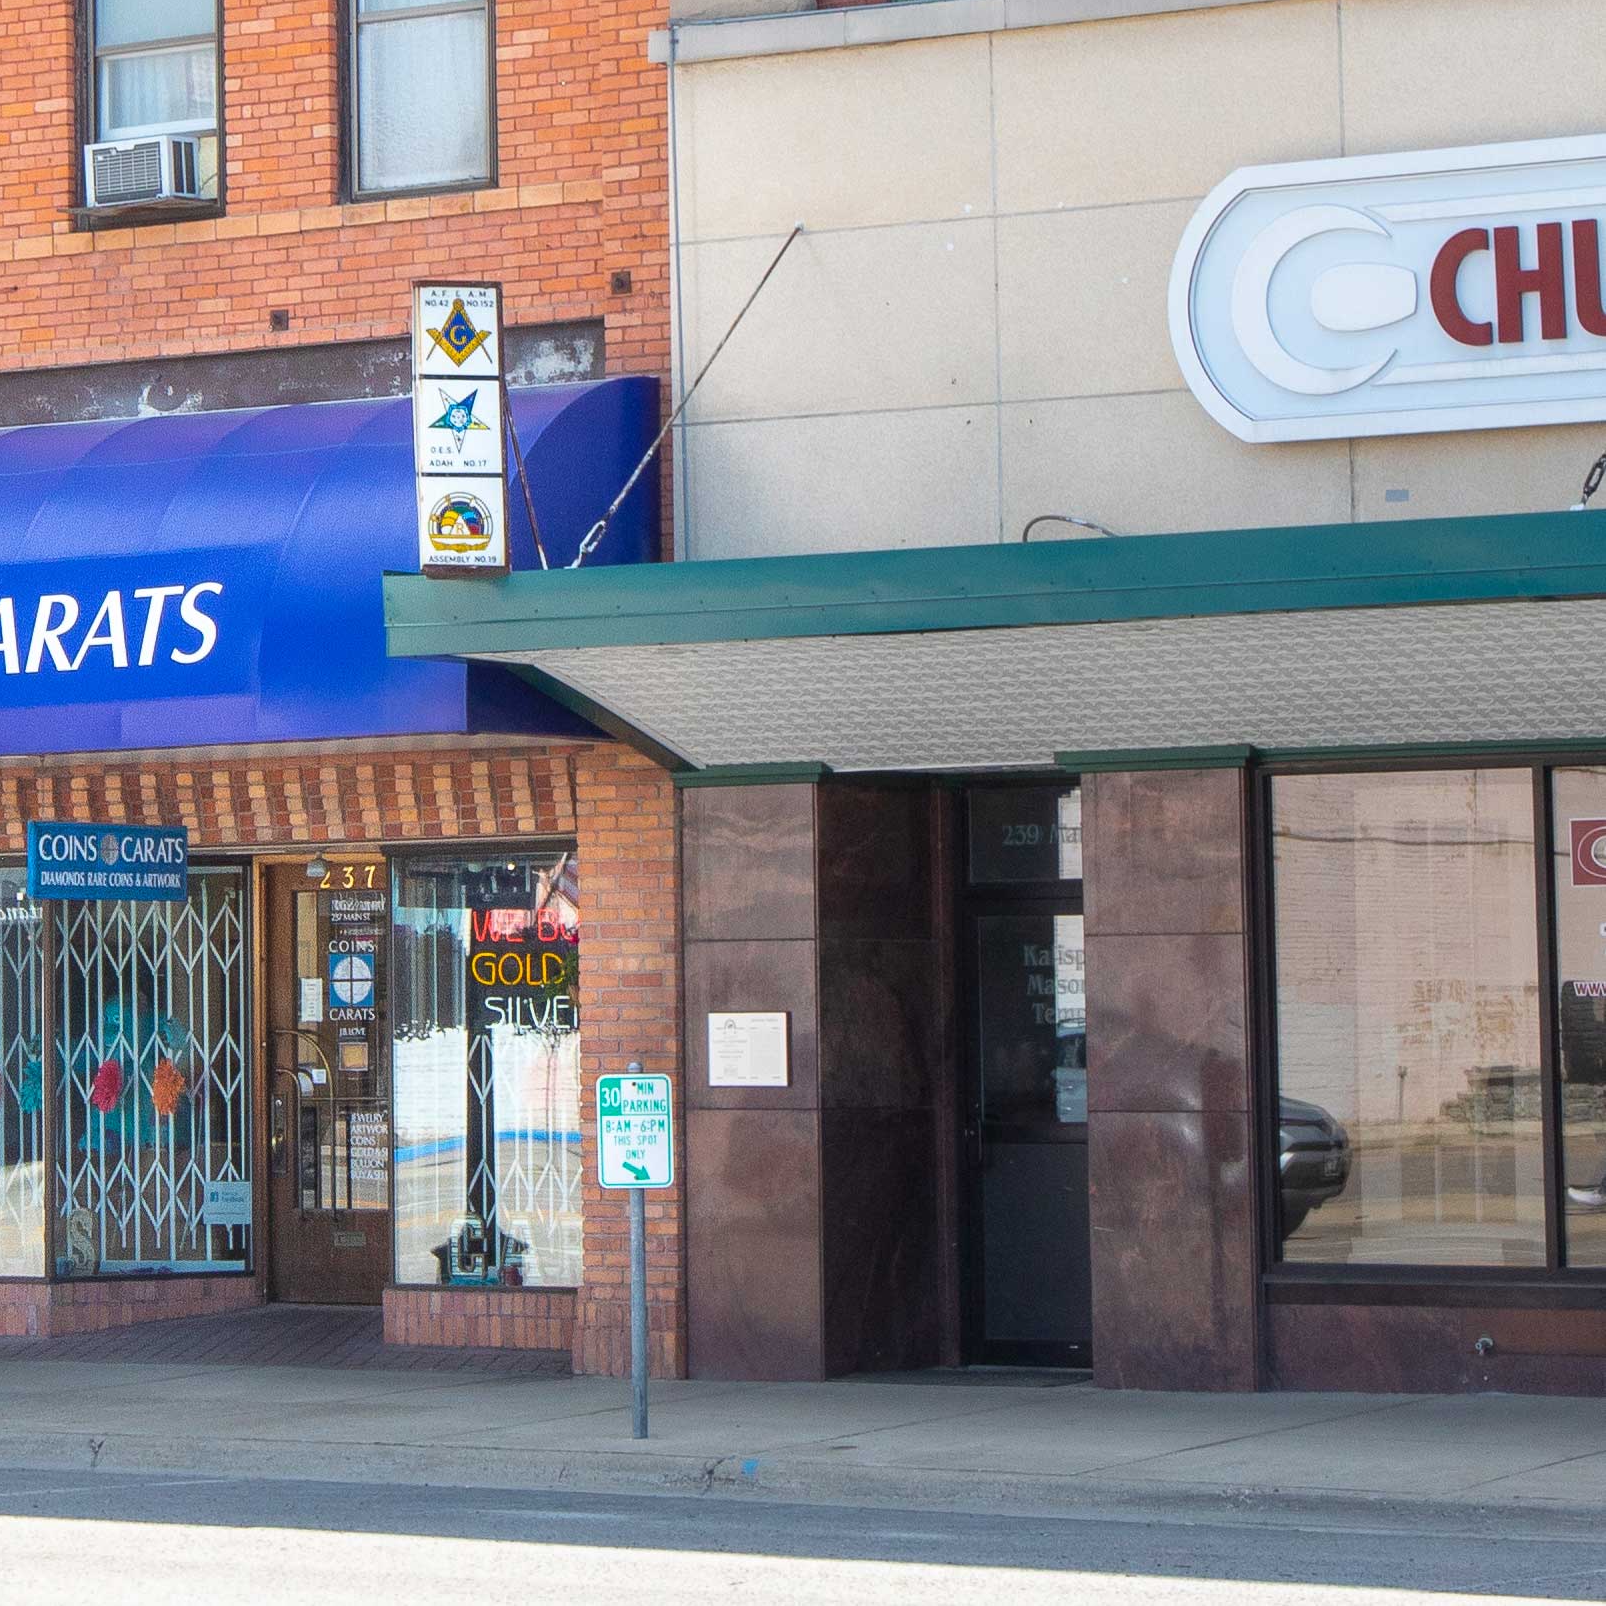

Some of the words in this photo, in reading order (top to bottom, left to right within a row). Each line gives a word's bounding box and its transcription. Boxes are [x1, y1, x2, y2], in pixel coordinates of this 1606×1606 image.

[429, 555, 470, 563] ASSEMBLY
[1002, 825, 1039, 845] 239
[39, 834, 97, 862] COINS
[121, 836, 184, 864] CARATS
[87, 872, 107, 886] RARE
[109, 873, 133, 887] COINS
[135, 874, 141, 886] &
[142, 874, 181, 888] ARTWORK
[319, 865, 376, 889] 237
[473, 909, 523, 942] WE
[328, 940, 375, 953] COINS
[472, 952, 566, 986] GOLD
[329, 1008, 376, 1021] CARATS
[637, 1082, 654, 1095] MIN
[601, 1087, 621, 1107] 30
[623, 1099, 666, 1112] PARKING
[614, 1135, 631, 1146] THIS
[637, 1135, 657, 1146] SPOT
[625, 1149, 645, 1160] ONLY
